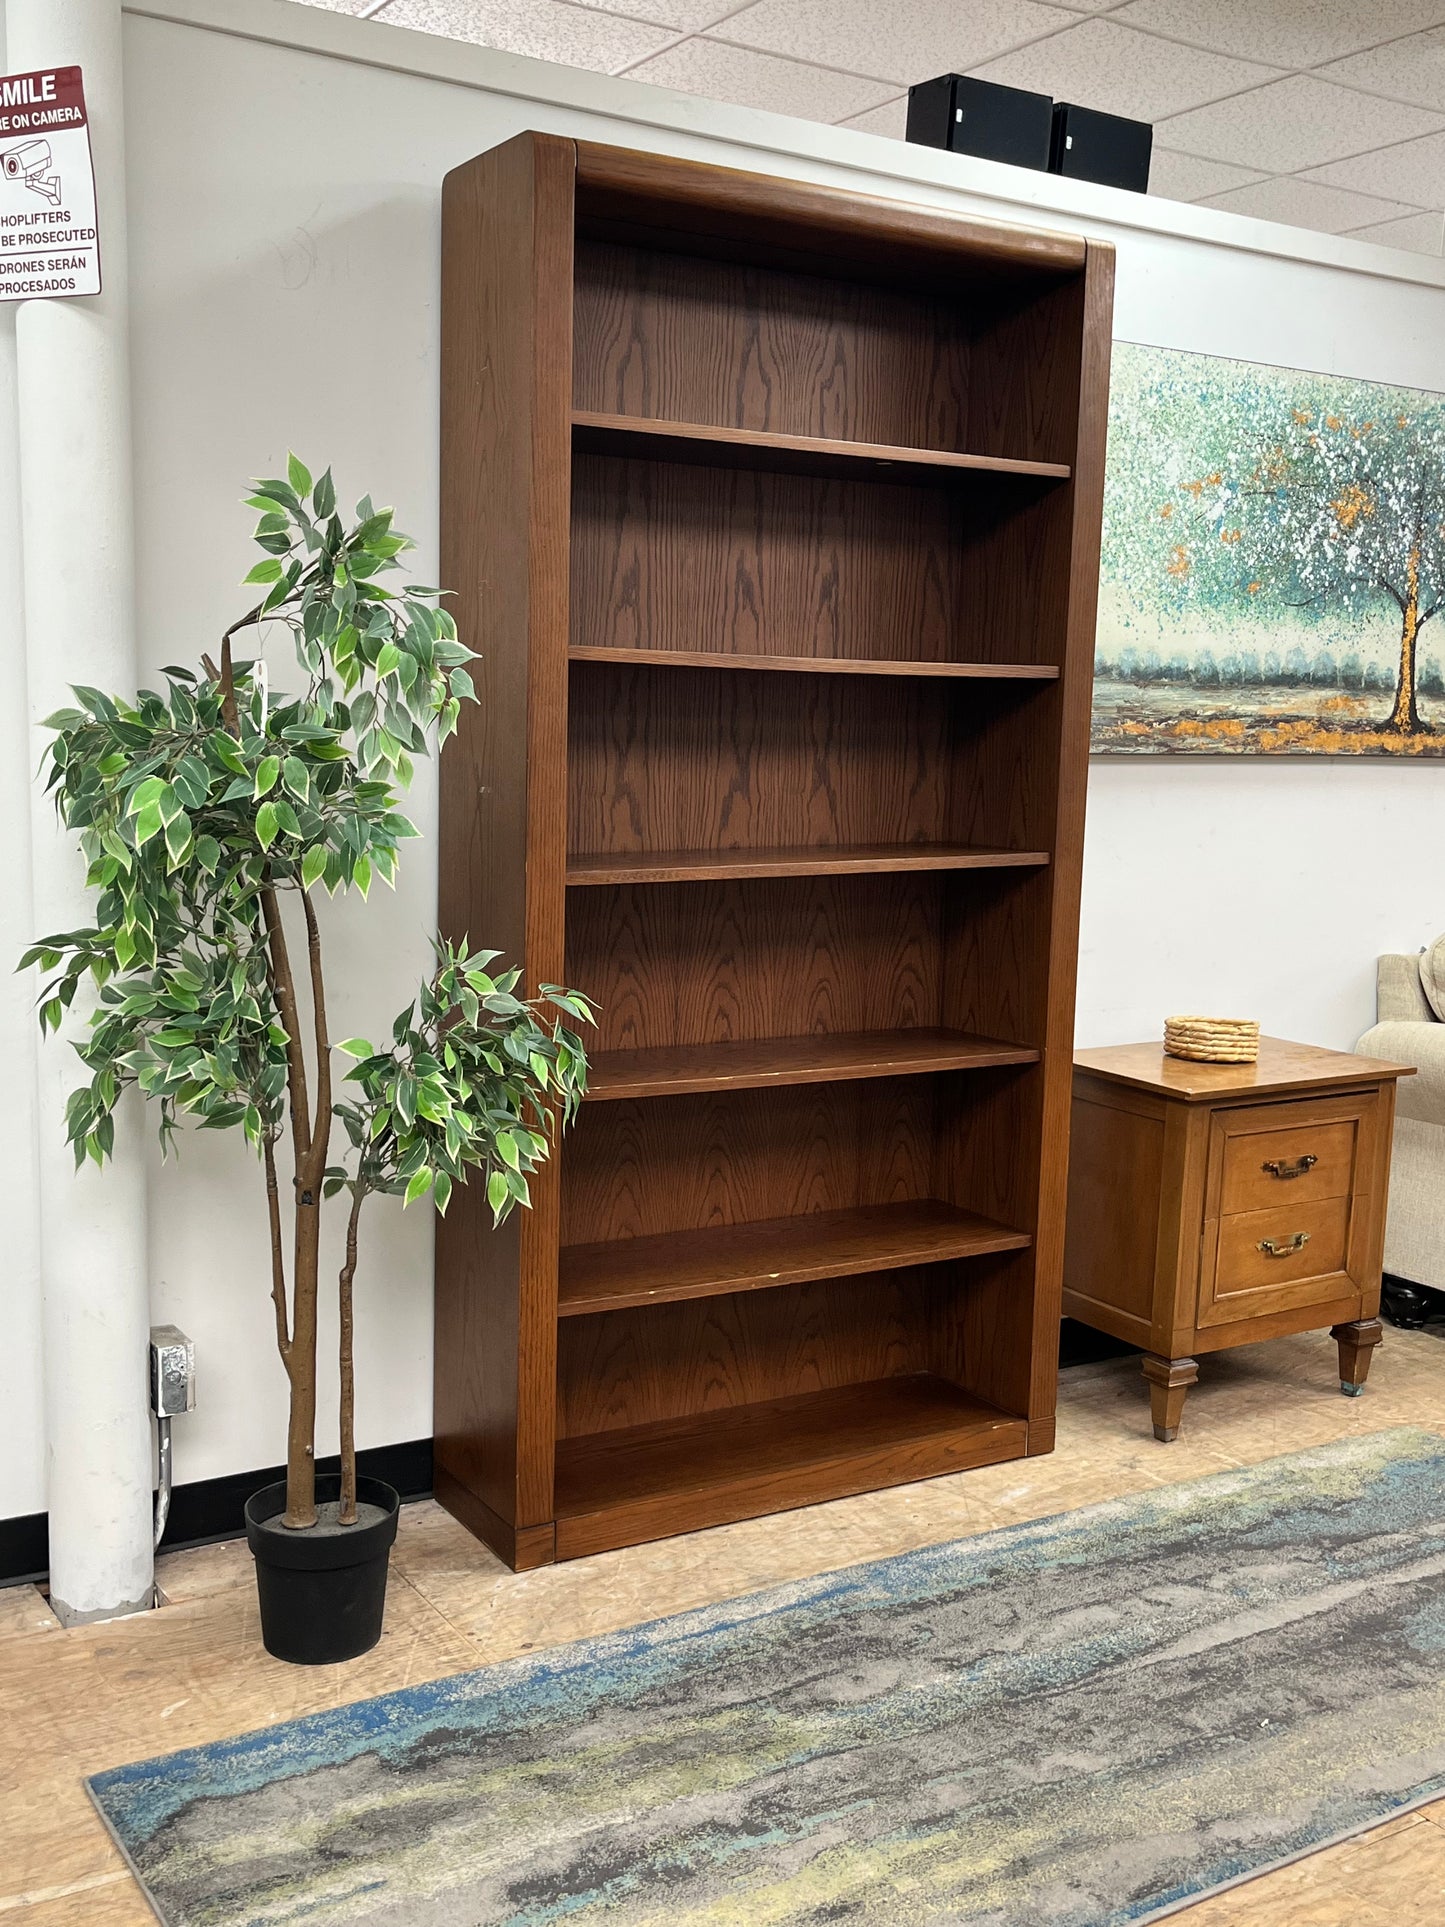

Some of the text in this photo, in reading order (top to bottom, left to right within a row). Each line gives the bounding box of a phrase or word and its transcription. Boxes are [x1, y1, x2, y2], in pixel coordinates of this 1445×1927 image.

[0, 74, 57, 107] MILE
[12, 113, 30, 129] ON
[31, 106, 83, 126] CAMERA
[0, 210, 71, 227] HOPLIFTERS
[1, 228, 96, 247] BE PROSECUTED
[47, 255, 86, 271] SERÁN
